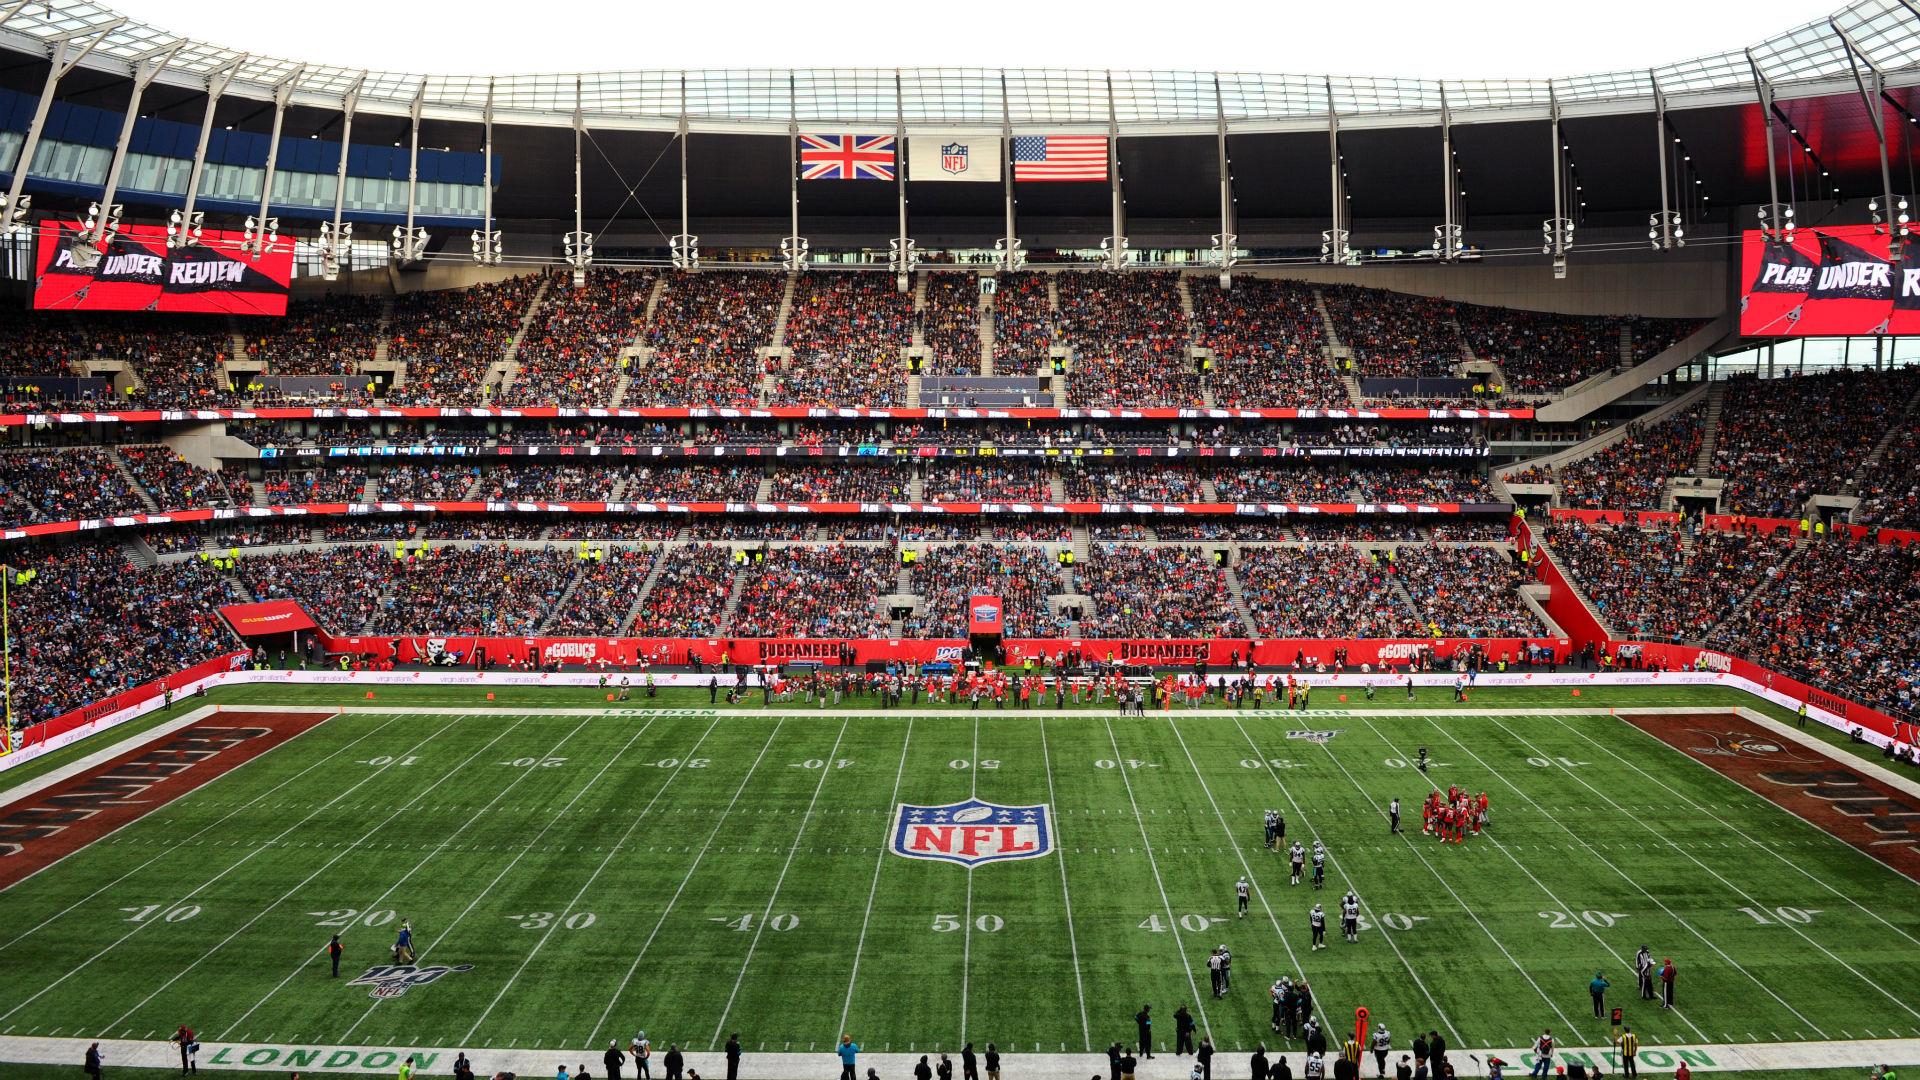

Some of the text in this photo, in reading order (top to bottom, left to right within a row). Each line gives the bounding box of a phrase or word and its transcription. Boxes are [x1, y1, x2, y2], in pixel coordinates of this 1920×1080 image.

[944, 156, 966, 171] NFL
[102, 254, 164, 275] UNDER
[170, 261, 246, 284] REVIEW
[1762, 262, 1813, 285] PLAY
[1817, 262, 1891, 290] UNDER
[546, 642, 595, 658] #GOBUCS
[759, 642, 849, 660] BUCCANEER
[910, 826, 1034, 856] NFL
[124, 904, 202, 922] 10
[315, 908, 397, 927] 20
[519, 912, 597, 930] 30
[1538, 910, 1616, 928] 20
[1736, 906, 1812, 924] 10
[726, 913, 800, 932] 40
[932, 914, 1004, 933] 50
[1137, 914, 1210, 933] 40
[375, 988, 400, 996] NFL
[1614, 1010, 1621, 1019] 2
[208, 1048, 439, 1070] LONDON
[1309, 1062, 1320, 1072] 55
[1486, 1050, 1718, 1071] LONDON
